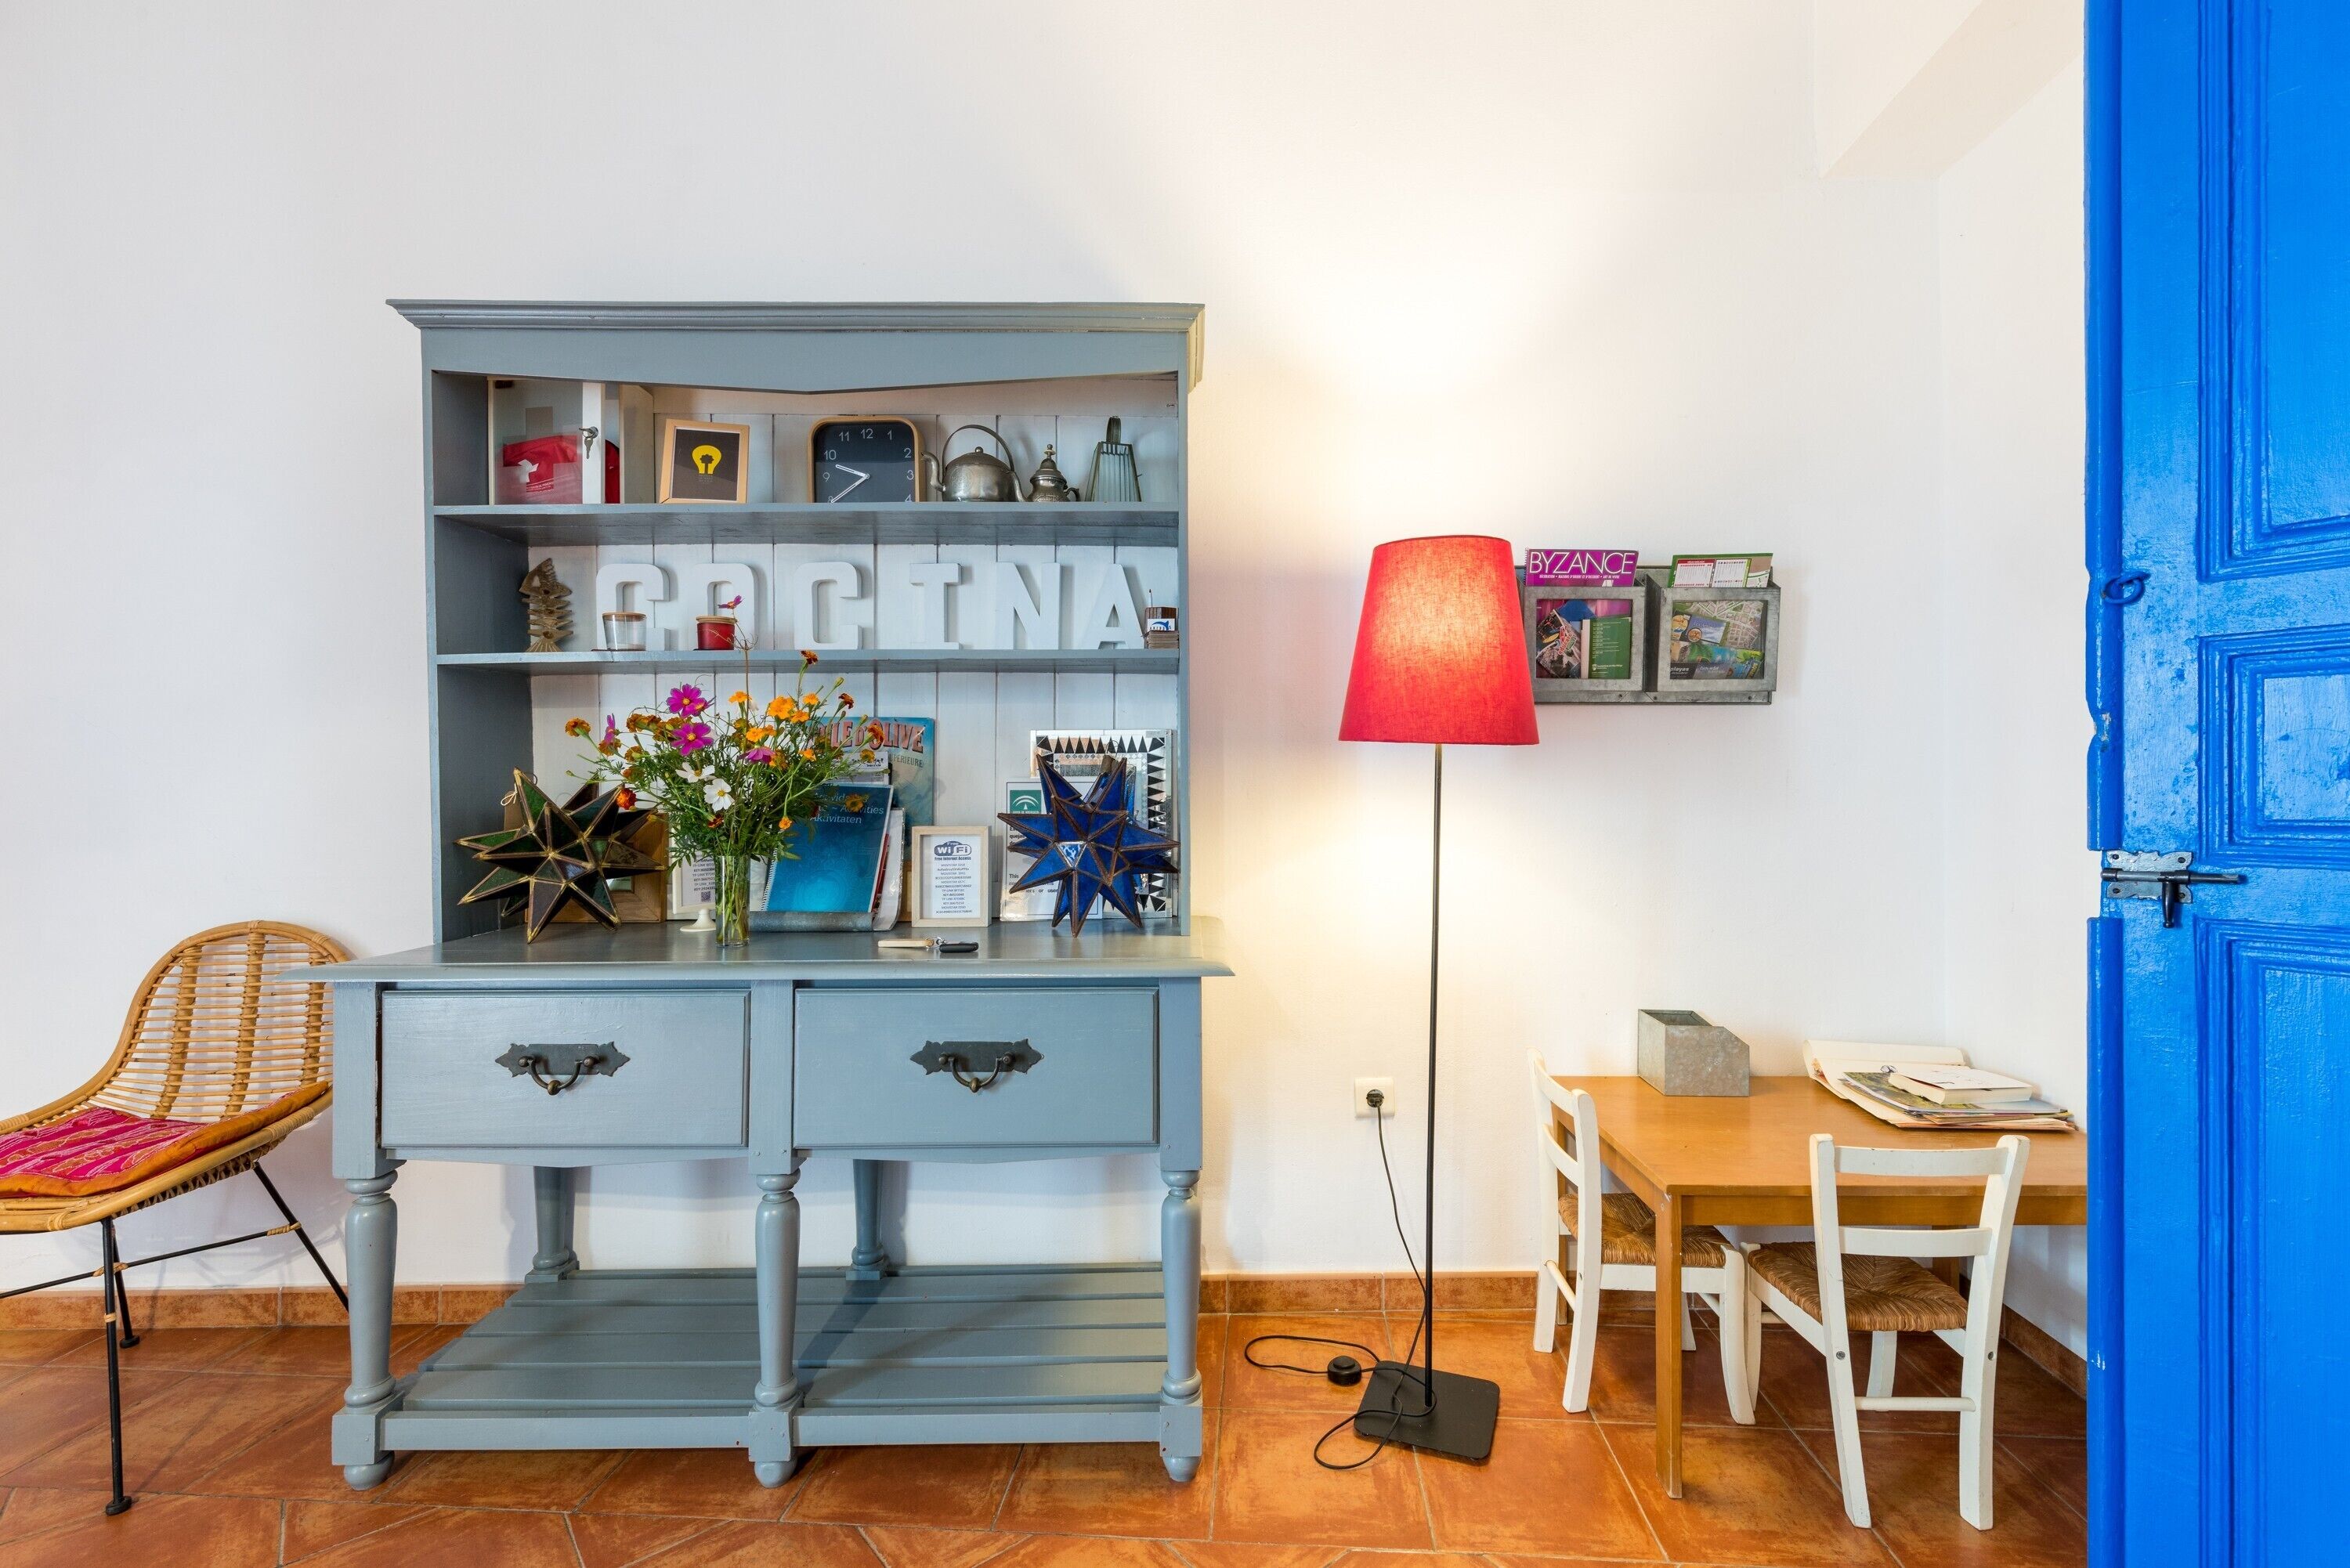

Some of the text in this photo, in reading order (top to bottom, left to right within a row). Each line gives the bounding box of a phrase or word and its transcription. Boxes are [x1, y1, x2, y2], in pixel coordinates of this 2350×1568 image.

[839, 432, 849, 442] 11
[860, 428, 873, 439] 12
[887, 430, 892, 440] 1
[824, 450, 837, 461] 10
[903, 447, 912, 458] 2
[822, 471, 830, 482] 9
[906, 469, 914, 480] 3
[1529, 551, 1636, 574] BYZANCE
[888, 753, 924, 768] UPERIEURE
